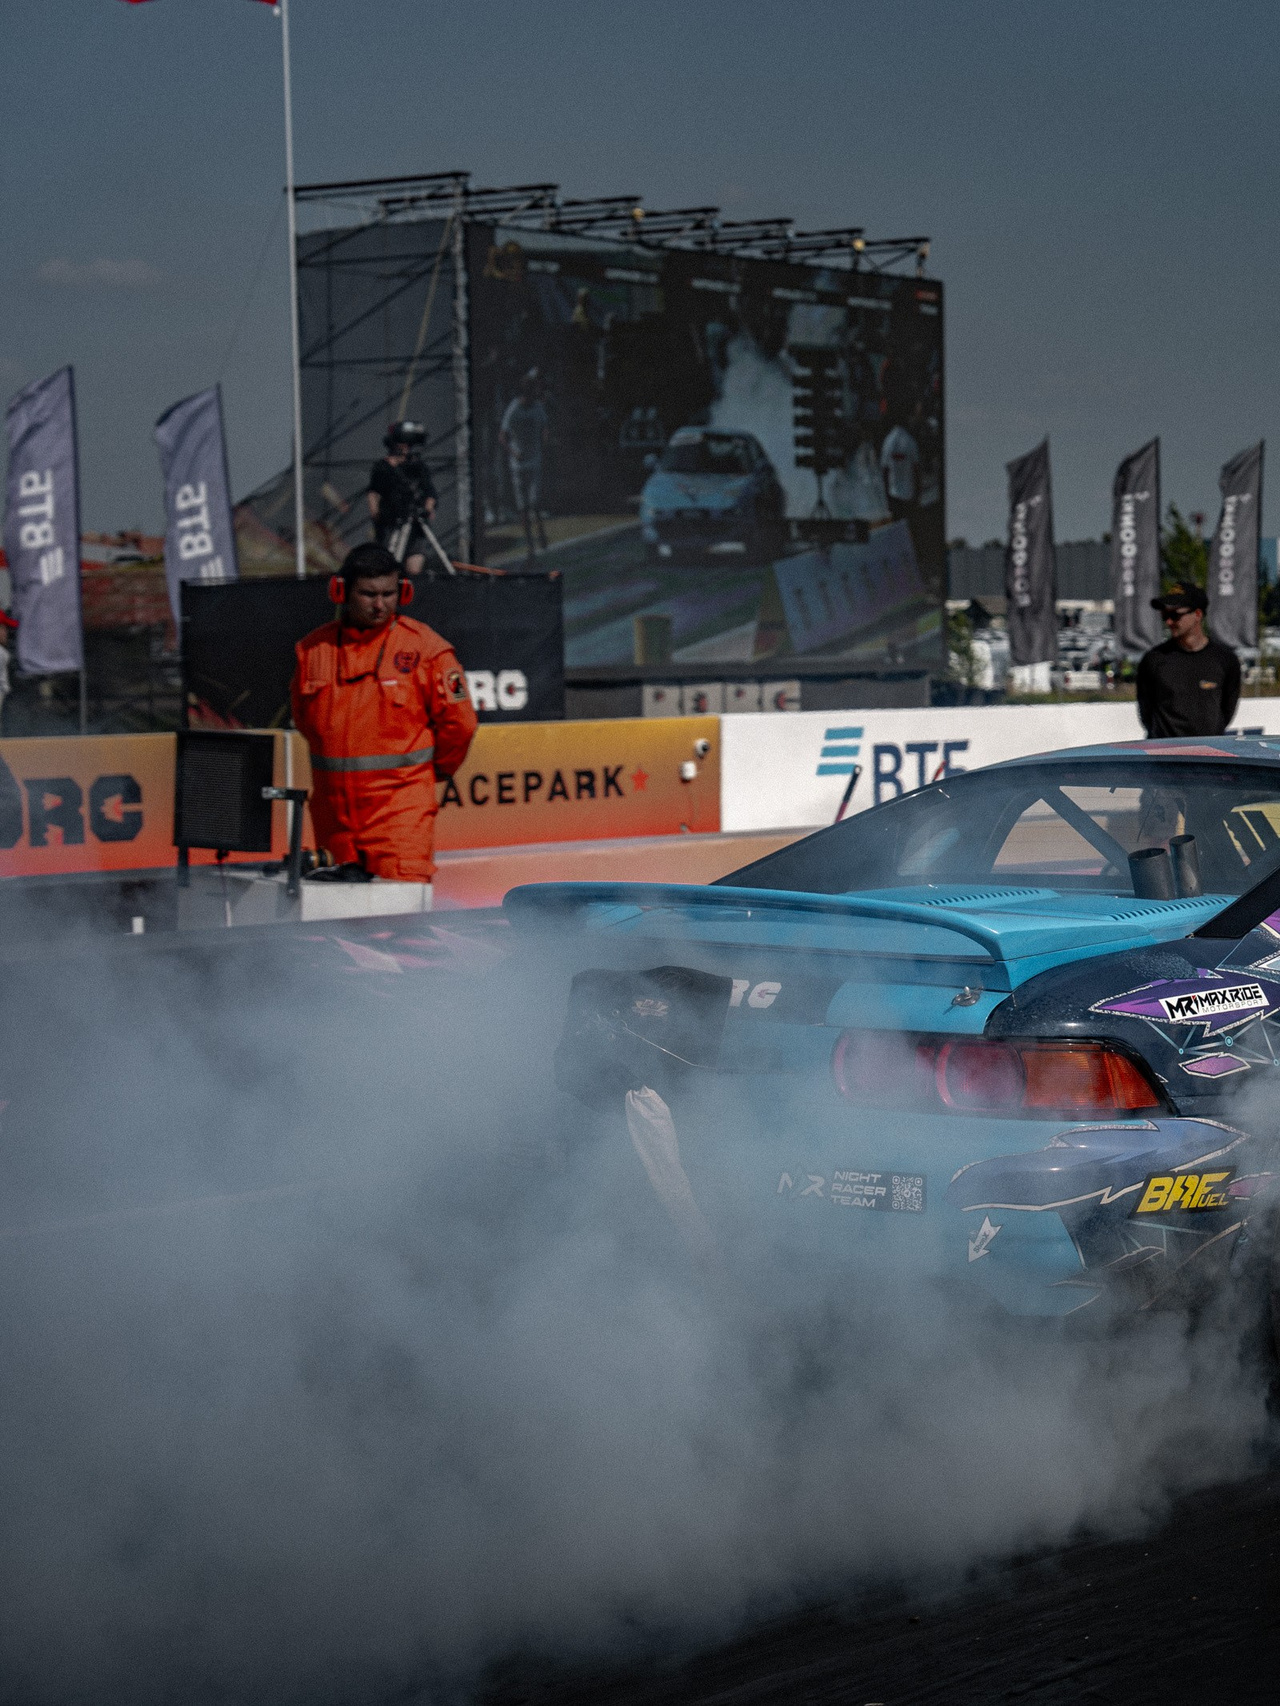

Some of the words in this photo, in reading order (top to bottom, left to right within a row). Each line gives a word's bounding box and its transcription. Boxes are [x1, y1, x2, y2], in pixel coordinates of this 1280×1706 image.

[1201, 999, 1264, 1014] MOTORSPORT
[833, 1170, 882, 1184] NIGHT
[831, 1182, 887, 1196] RACER
[831, 1195, 877, 1207] TEAM
